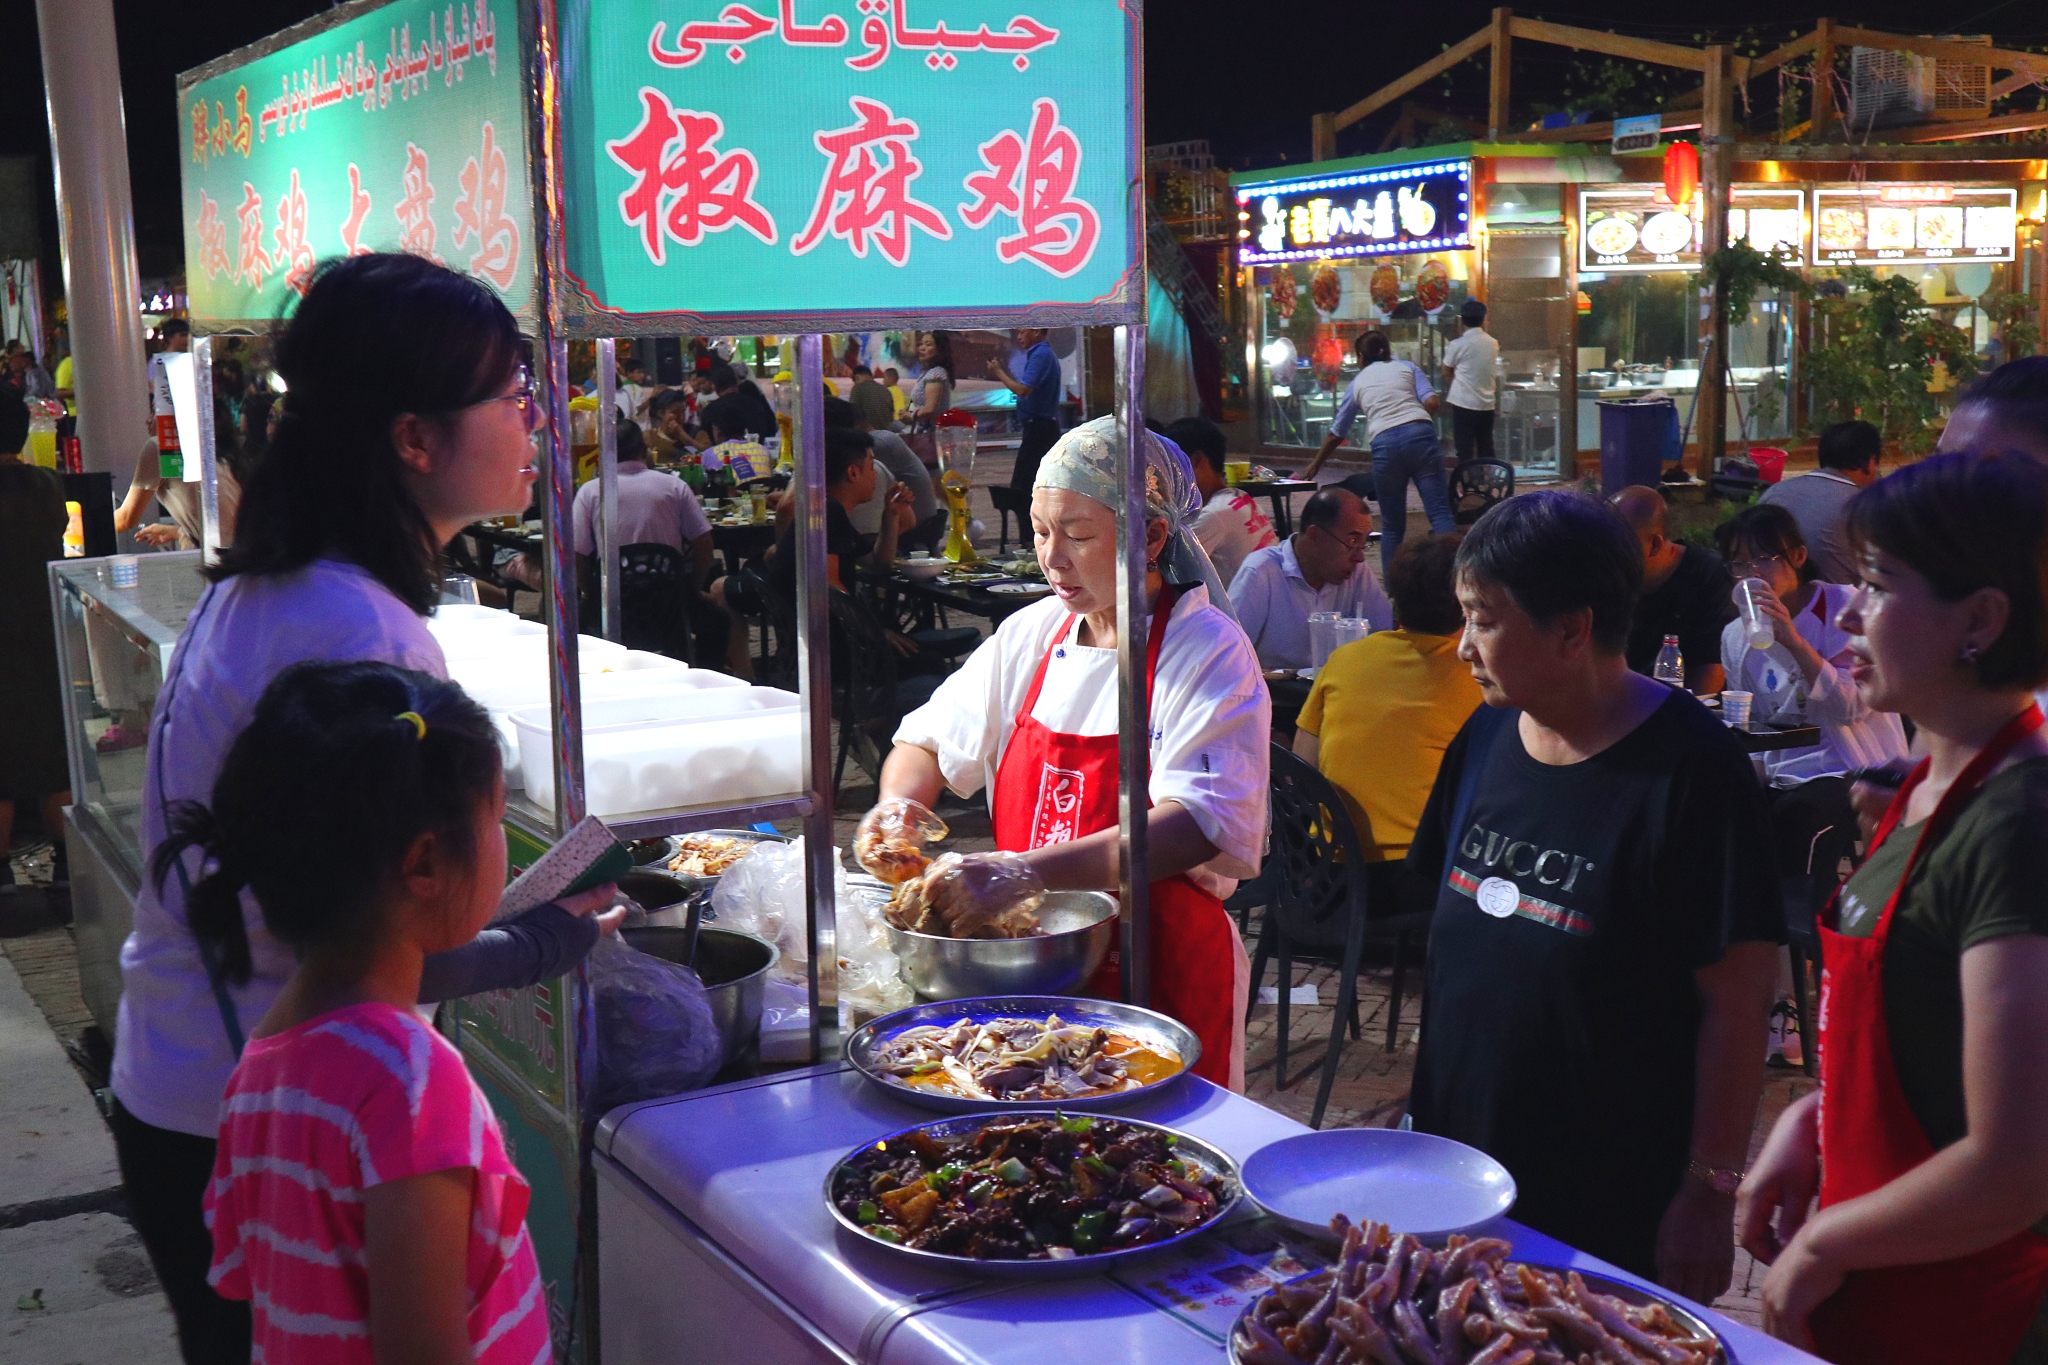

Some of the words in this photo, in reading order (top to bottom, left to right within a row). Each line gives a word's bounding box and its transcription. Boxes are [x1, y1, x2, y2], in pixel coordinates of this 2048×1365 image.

[197, 167, 316, 297] 椒麻鸡
[605, 86, 1101, 278] 椒麻鸡
[1461, 823, 1587, 893] GUCCI
